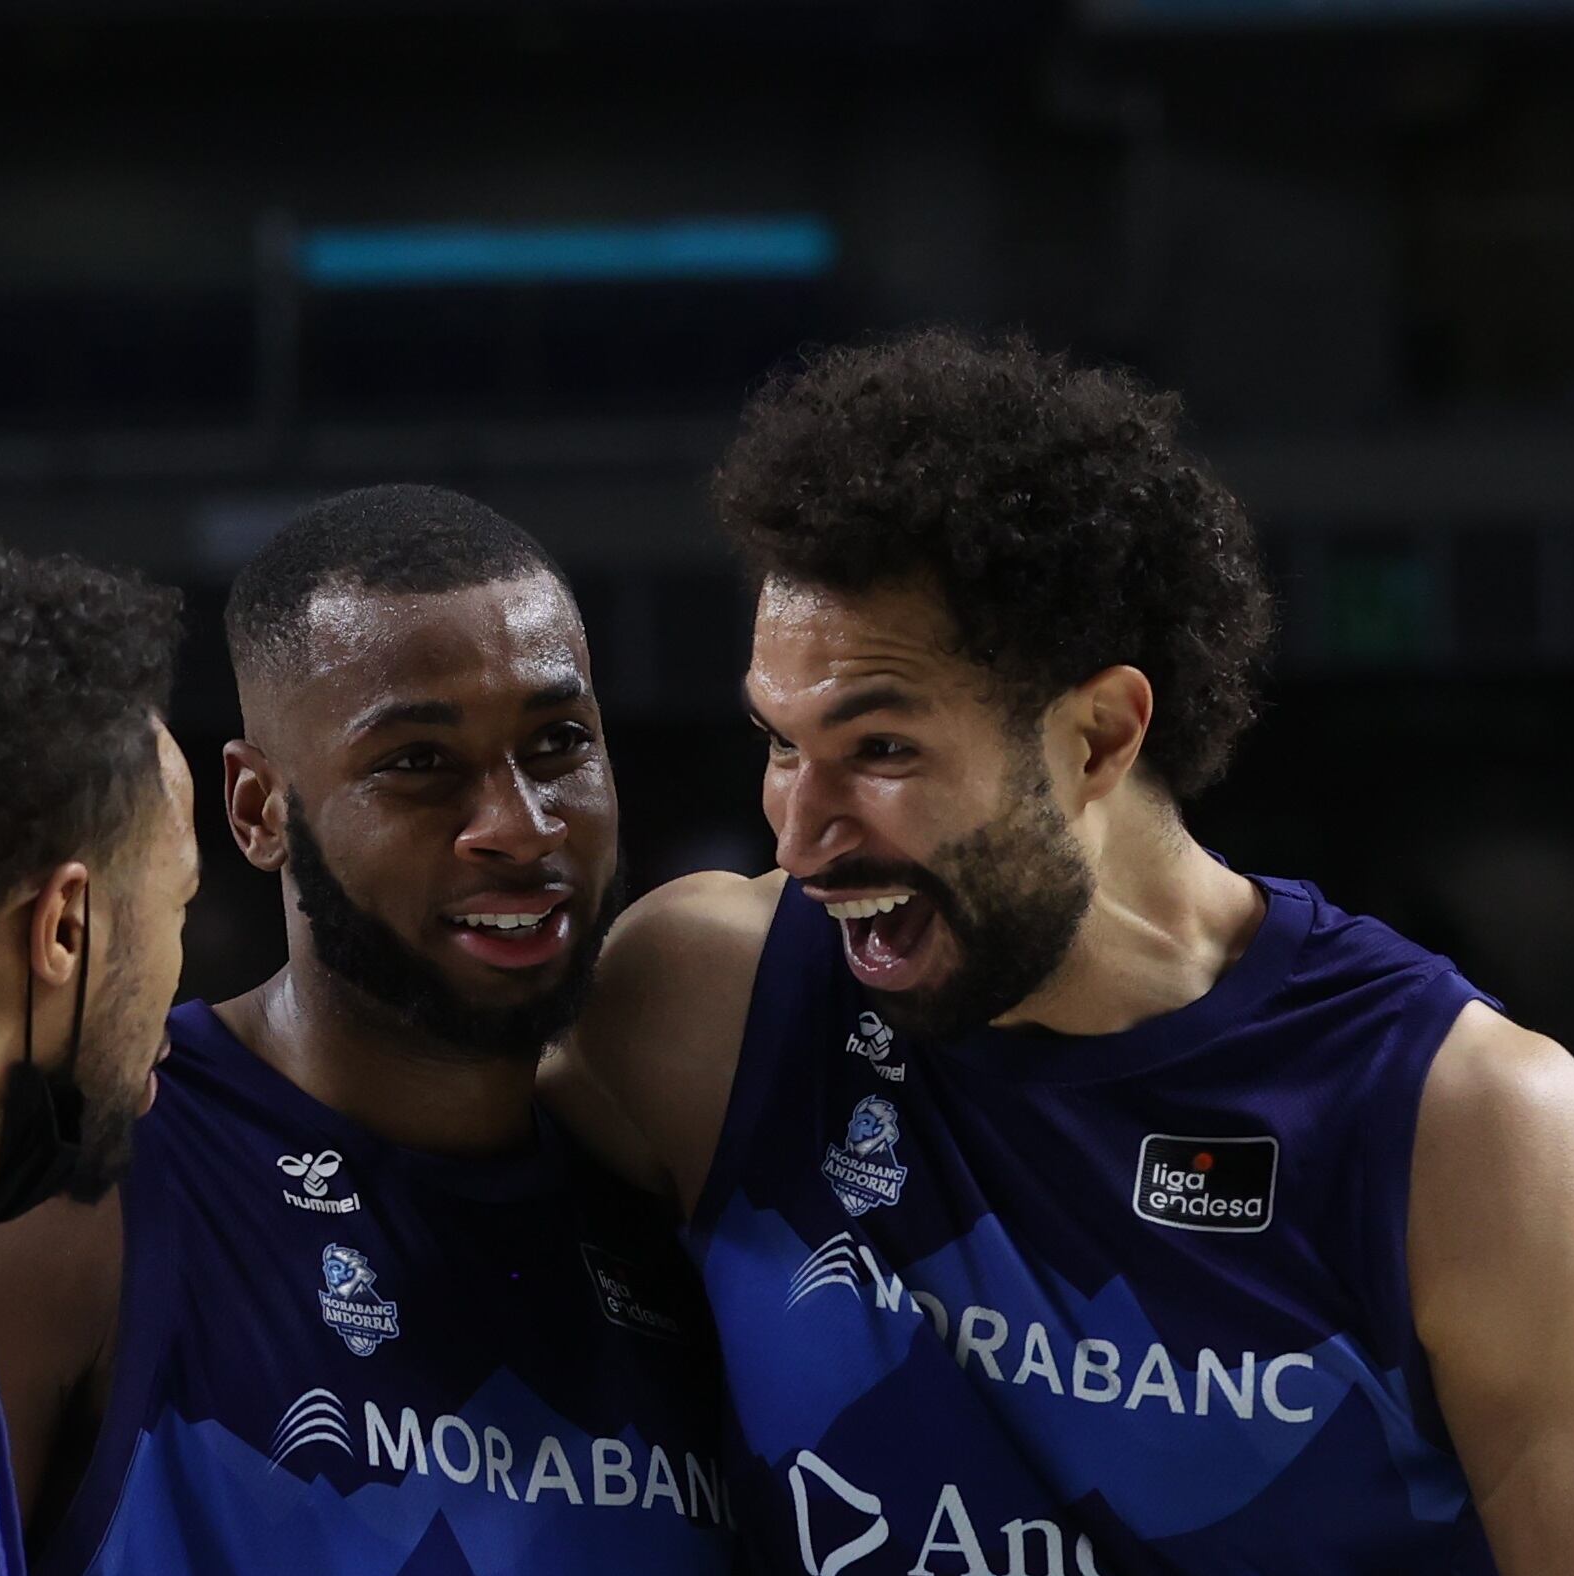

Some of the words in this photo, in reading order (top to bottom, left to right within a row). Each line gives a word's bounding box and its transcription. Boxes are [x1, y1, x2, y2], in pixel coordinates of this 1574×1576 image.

[828, 1149, 904, 1181] MORABANC
[1152, 1163, 1205, 1192] liga
[824, 1160, 897, 1201] ANDORRA
[282, 1189, 361, 1214] hummel
[1149, 1193, 1263, 1217] endesa
[322, 1295, 394, 1316] MORABANC
[326, 1306, 395, 1333] ANDORRA
